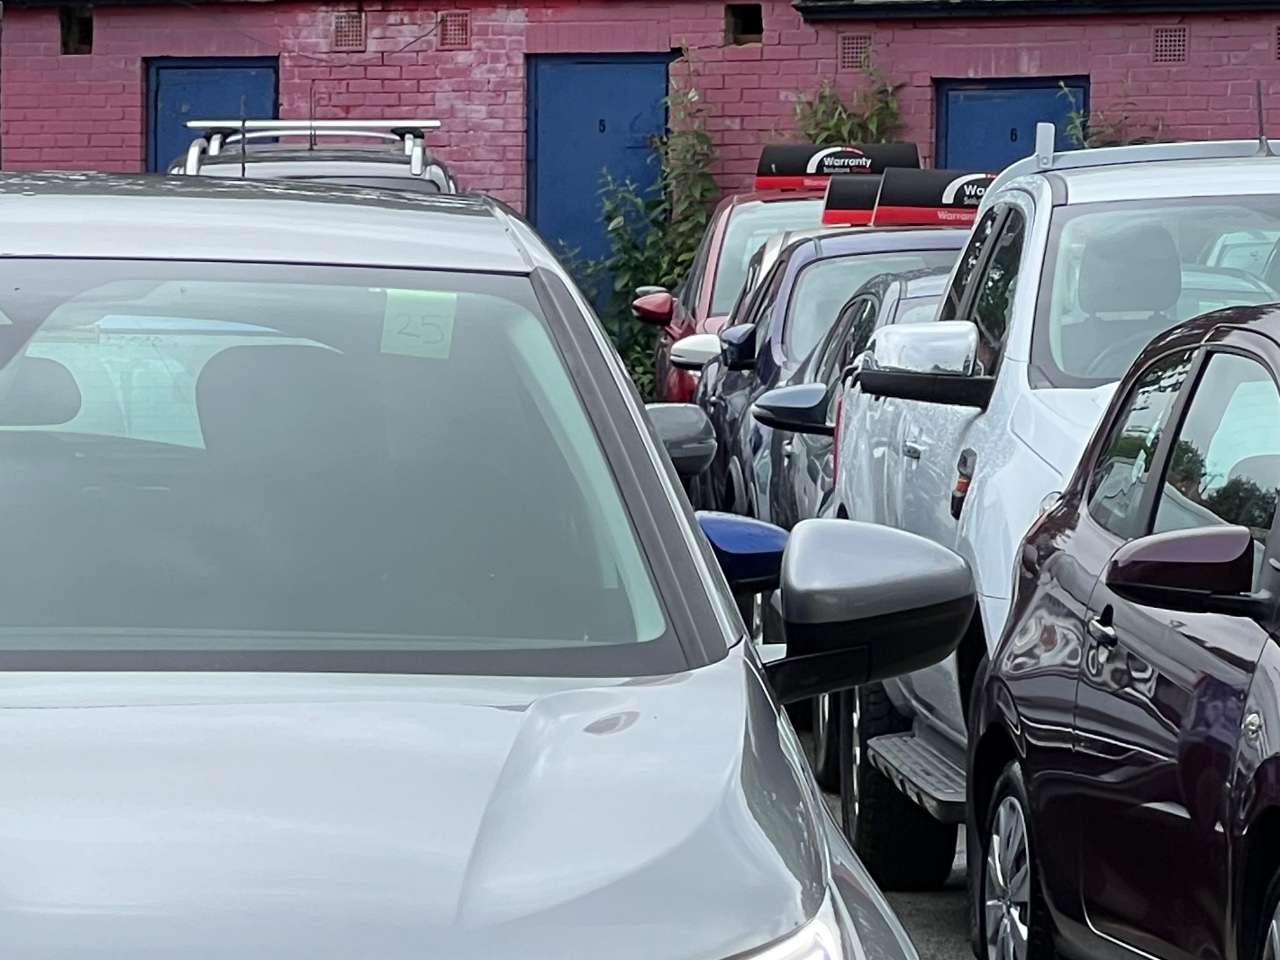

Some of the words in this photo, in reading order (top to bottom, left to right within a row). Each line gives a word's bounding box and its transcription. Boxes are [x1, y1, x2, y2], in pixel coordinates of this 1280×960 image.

[599, 119, 606, 134] 5
[1010, 127, 1018, 142] 6
[823, 157, 872, 168] Warranty
[963, 184, 988, 197] Wa
